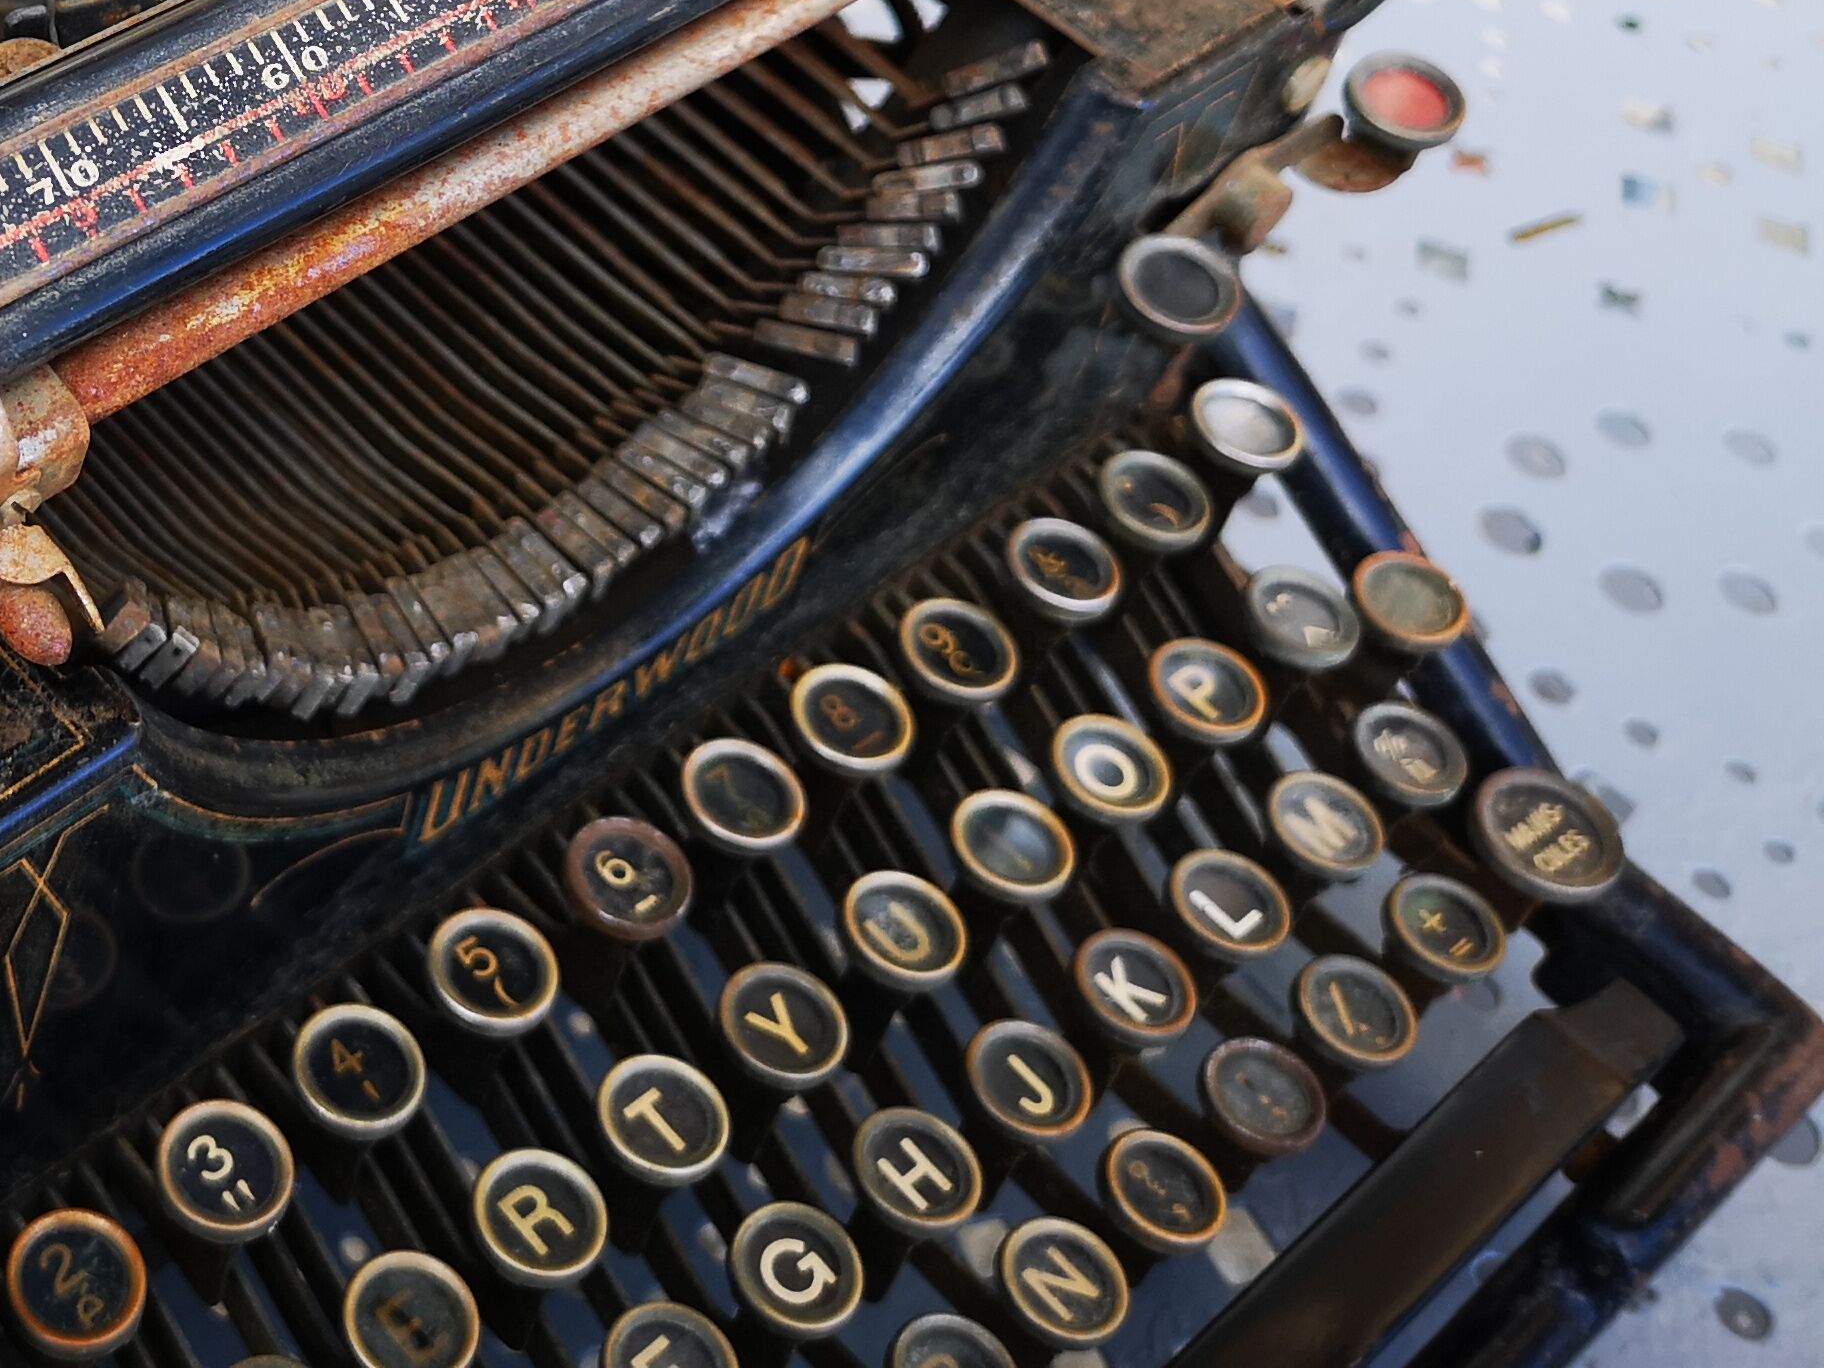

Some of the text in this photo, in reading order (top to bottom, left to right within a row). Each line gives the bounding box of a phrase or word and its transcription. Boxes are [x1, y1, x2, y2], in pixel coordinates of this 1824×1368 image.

[26, 159, 99, 205] 70
[261, 45, 329, 90] 60
[919, 623, 957, 659] 9
[417, 535, 810, 844] UNDERWOOD
[821, 695, 859, 729] 8
[1168, 664, 1220, 720] P
[1074, 743, 1138, 800] O
[1284, 795, 1358, 859] M
[595, 849, 637, 888] 6
[865, 901, 931, 963] U
[1188, 889, 1263, 940] L
[455, 936, 499, 979] 5
[1093, 954, 1168, 1024] K
[744, 992, 810, 1055] Y
[331, 1038, 366, 1074] 4
[1006, 1053, 1054, 1115] J
[623, 1087, 687, 1152] T
[187, 1134, 234, 1181] 3
[876, 1136, 953, 1211] H
[498, 1185, 575, 1256] R
[39, 1242, 86, 1297] 2
[760, 1237, 838, 1305] G
[1021, 1245, 1100, 1322] N
